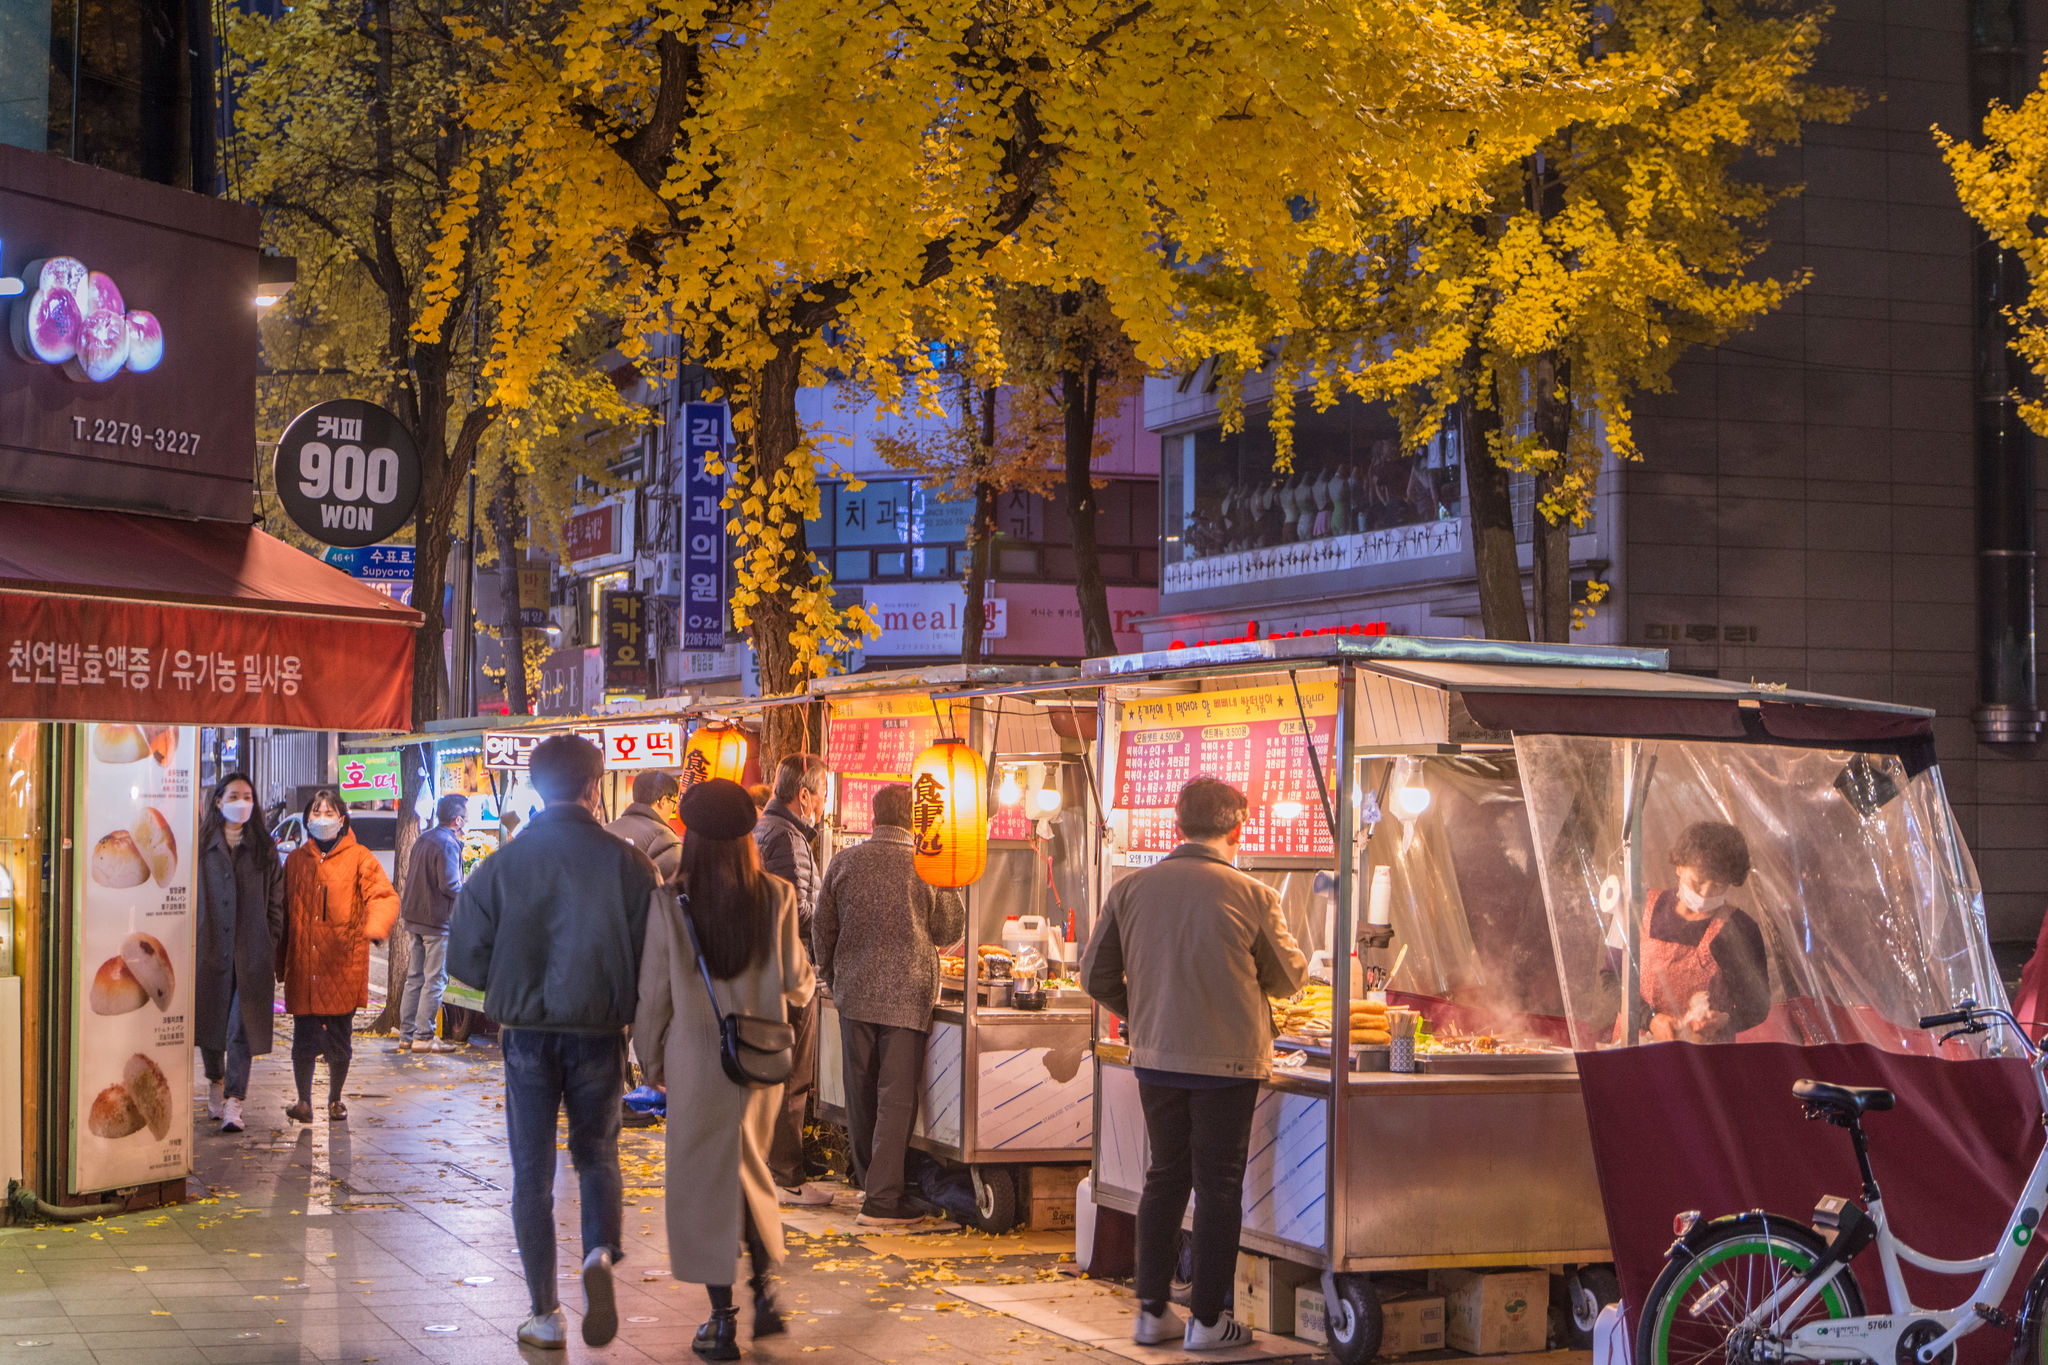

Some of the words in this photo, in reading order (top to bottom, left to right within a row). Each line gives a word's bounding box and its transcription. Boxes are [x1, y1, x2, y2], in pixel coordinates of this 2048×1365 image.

[73, 415, 201, 456] T.2279-3227
[317, 416, 362, 441] 커피
[299, 441, 399, 504] 900
[320, 504, 373, 532] WON
[845, 497, 901, 530] 치과
[370, 548, 416, 565] 수표로
[362, 565, 410, 578] Supyo-ro
[704, 616, 720, 629] 2F
[882, 603, 957, 631] meal
[612, 597, 641, 667] 카카오
[7, 639, 151, 692] 천연발효액종
[171, 649, 237, 694] 유기농
[242, 653, 303, 697] 밀사용
[1175, 700, 1199, 718] 먹어야
[1282, 721, 1296, 733] 기본
[612, 732, 674, 766] 호떡
[342, 761, 398, 795] 호떡
[1867, 1319, 1893, 1330] 57661
